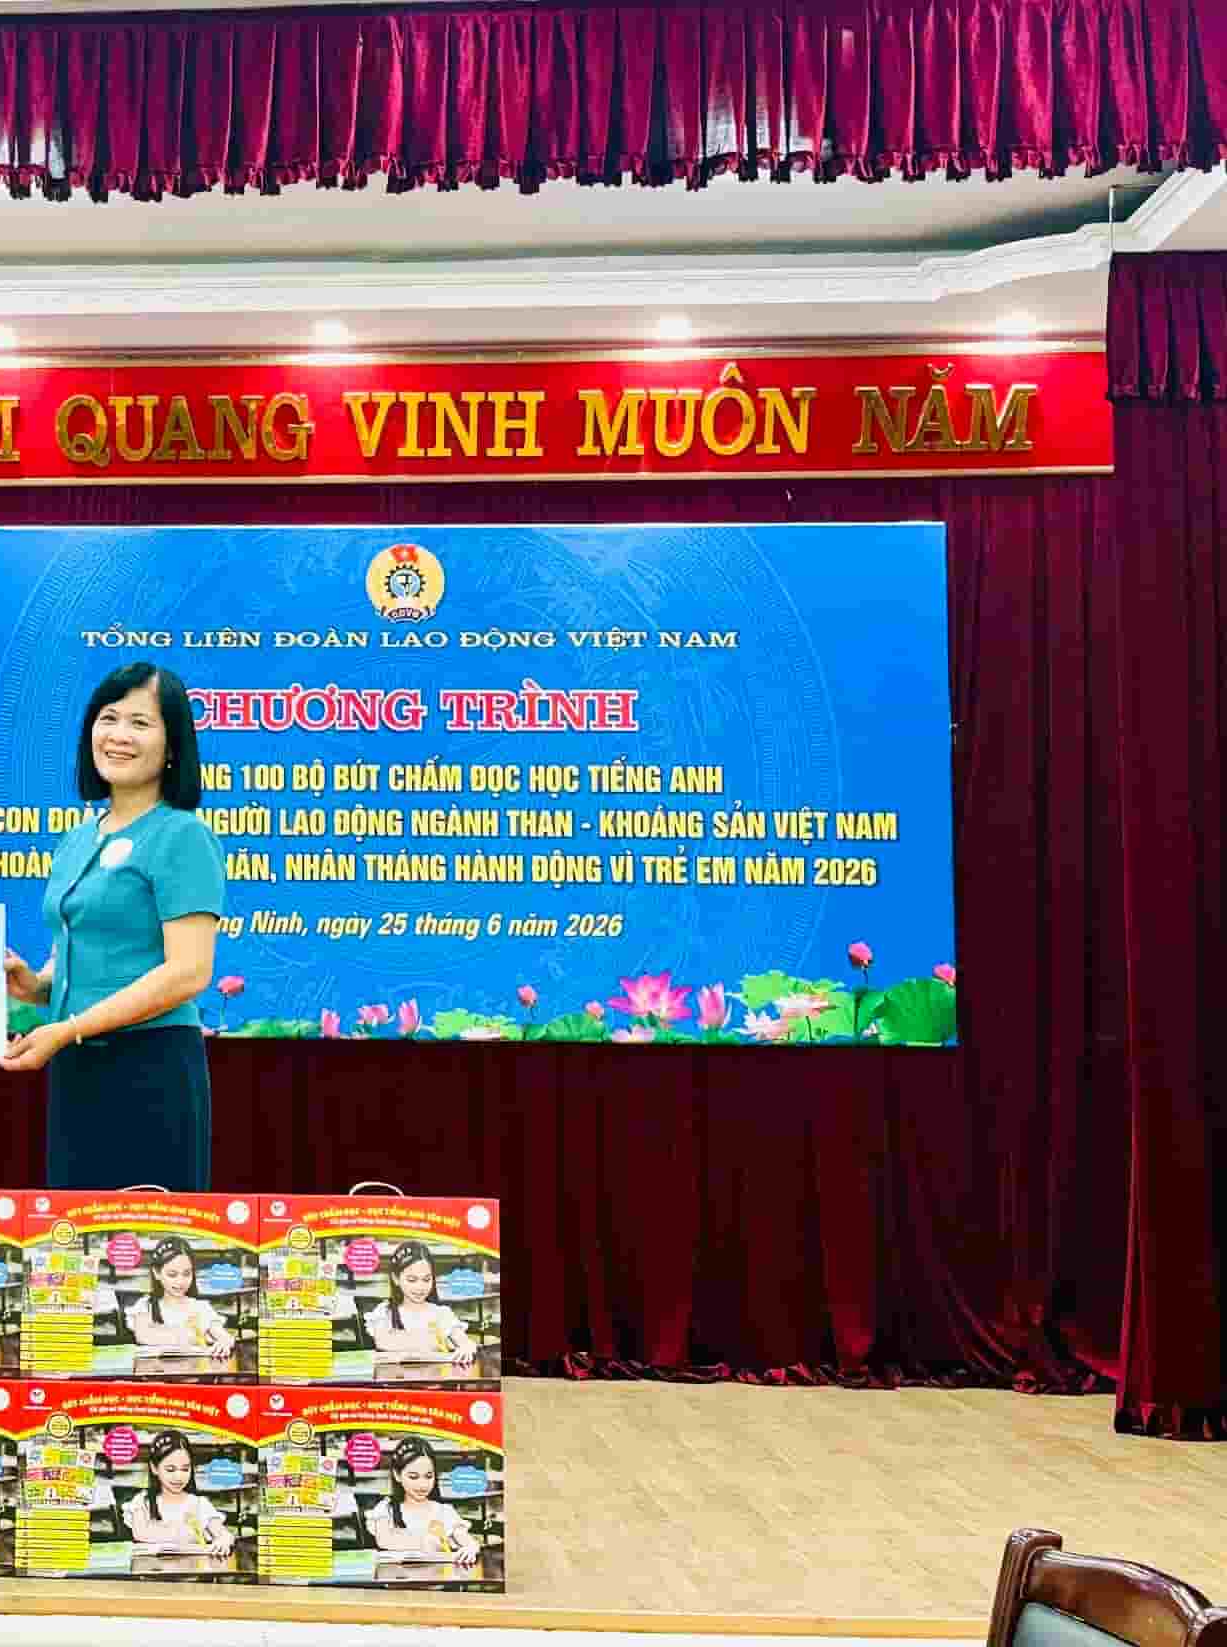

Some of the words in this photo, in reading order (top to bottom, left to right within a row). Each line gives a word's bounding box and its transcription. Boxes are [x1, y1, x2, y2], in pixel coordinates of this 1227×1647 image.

[55, 392, 315, 467] QUANG
[342, 389, 545, 458] VINH
[575, 362, 817, 457] MUÔN
[851, 362, 1040, 453] NĂM
[81, 622, 173, 648] TỔNG
[183, 628, 261, 648] LIÊN
[274, 627, 368, 648] ĐOÀN
[381, 631, 449, 648] LAO
[458, 628, 558, 651] ĐỘNG
[568, 627, 648, 652] VIỆT
[658, 631, 738, 648] NAM
[440, 679, 639, 733] TRÌNH
[241, 764, 285, 791] 100
[292, 759, 326, 798] BỘ
[334, 757, 380, 792] BÚT
[388, 757, 462, 792] CHẤM
[470, 765, 521, 798] ĐỌC
[529, 765, 580, 798] HỌC
[588, 757, 661, 793] TIẾNG
[670, 766, 724, 793] ANH
[280, 810, 326, 836] LAO
[334, 807, 404, 843] ĐỘNG
[411, 805, 499, 837] NGÀNH
[507, 810, 573, 837] THAN
[599, 806, 703, 838] KHOÁNG
[713, 800, 766, 839] SẢN
[773, 806, 828, 845] VIỆT
[836, 812, 898, 840] NAM
[285, 848, 356, 882] NHÂN
[363, 849, 446, 882] THÁNG
[455, 850, 523, 883] HÀNH
[531, 850, 602, 888] ĐỘNG
[610, 850, 634, 883] VÌ
[642, 845, 688, 884] TRẺ
[697, 857, 736, 884] EM
[745, 850, 807, 884] NĂM
[813, 858, 878, 886] 2026
[250, 910, 308, 936] Ninh,
[316, 916, 373, 938] ngày
[378, 912, 407, 936] 25
[415, 912, 480, 941] tháng
[487, 914, 501, 936] 6
[508, 914, 558, 937] năm
[564, 914, 623, 938] 2026
